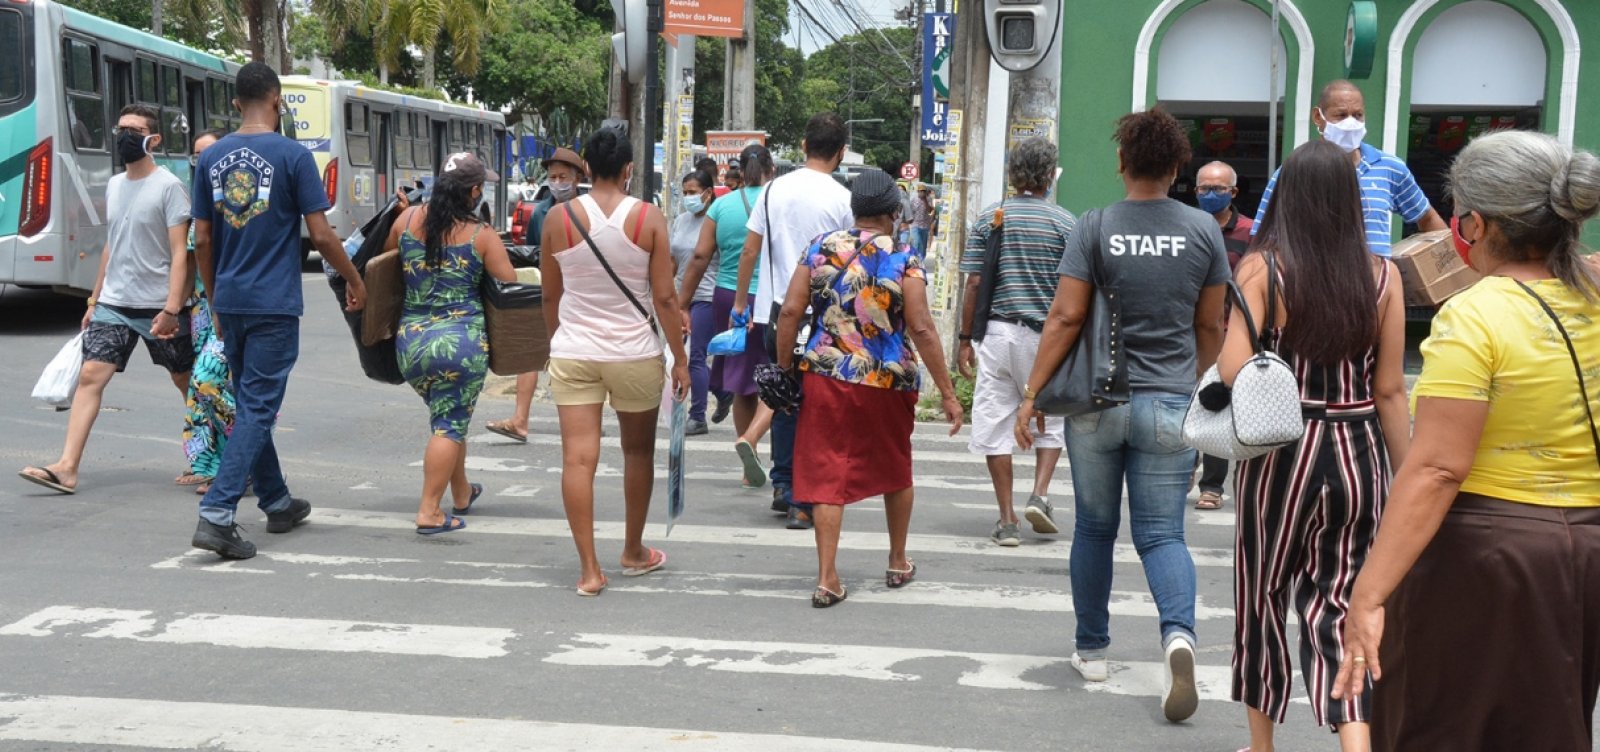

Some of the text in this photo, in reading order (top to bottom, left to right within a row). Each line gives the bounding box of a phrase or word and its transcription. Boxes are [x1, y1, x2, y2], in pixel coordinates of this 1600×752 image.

[669, 0, 700, 8] Avenida
[669, 11, 732, 24] Senhor dos Passos
[1109, 234, 1187, 257] STAFF
